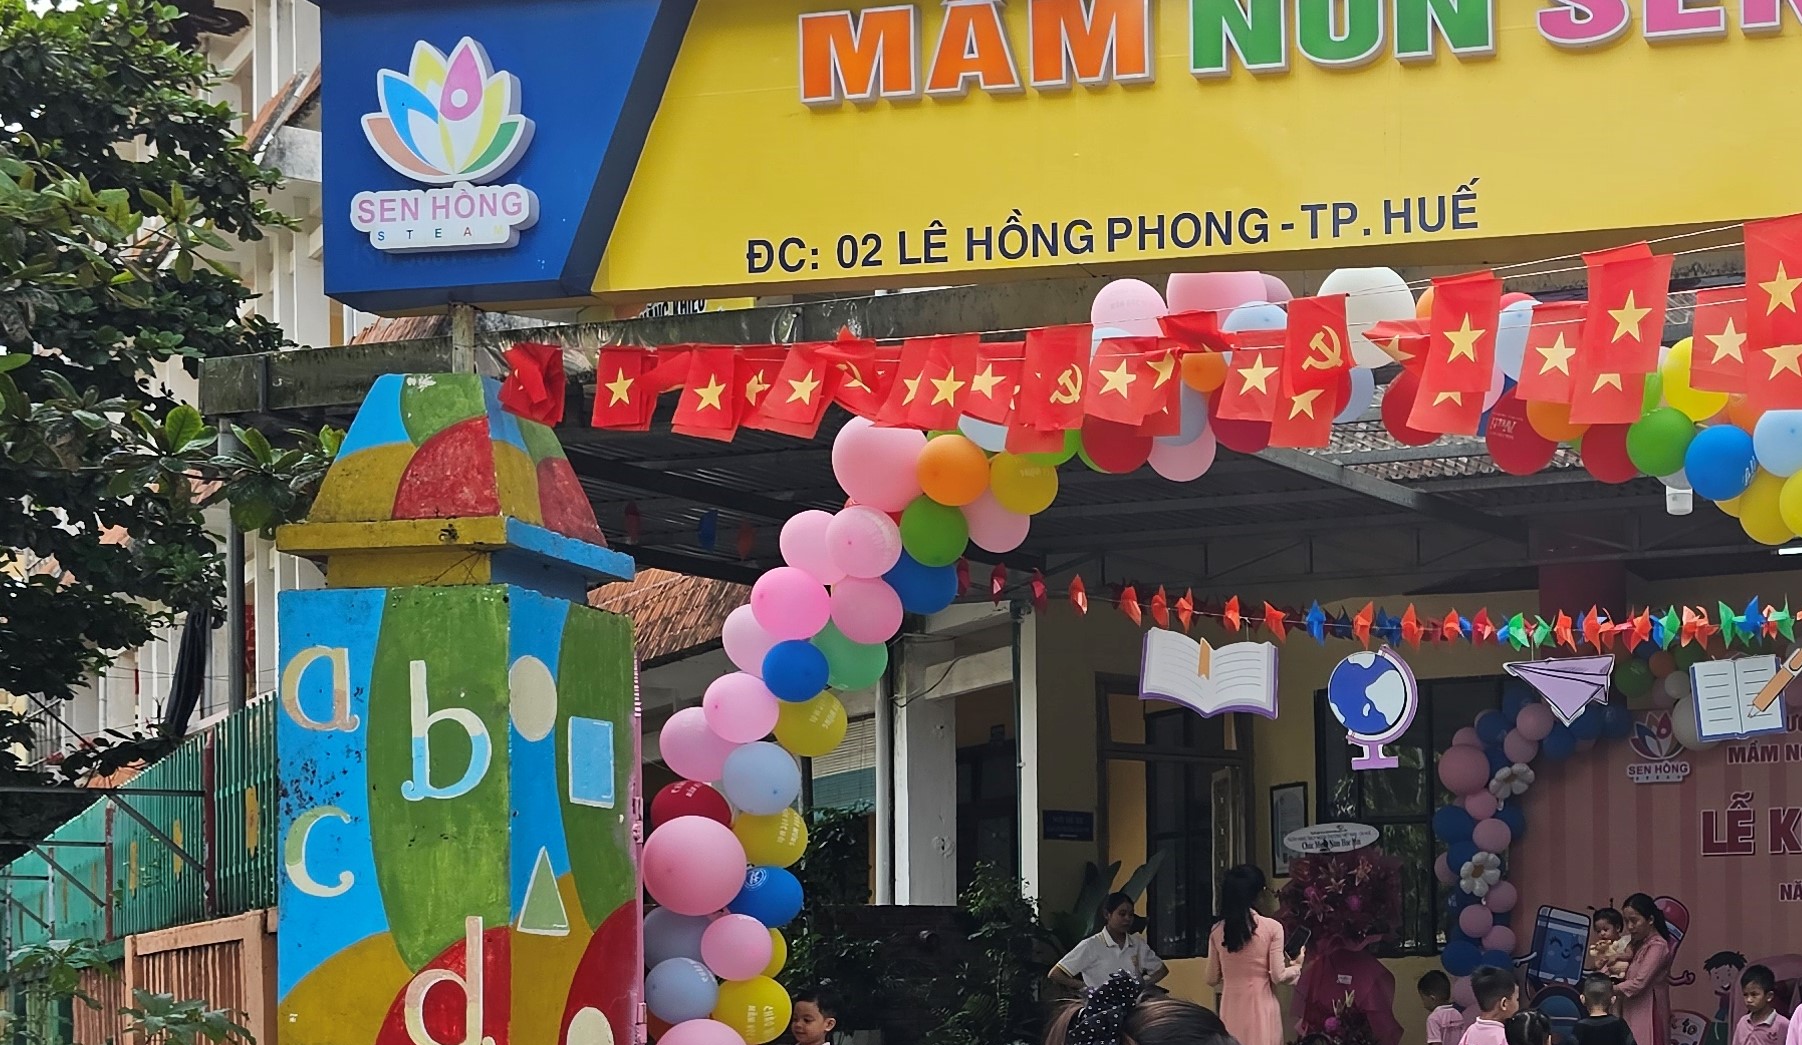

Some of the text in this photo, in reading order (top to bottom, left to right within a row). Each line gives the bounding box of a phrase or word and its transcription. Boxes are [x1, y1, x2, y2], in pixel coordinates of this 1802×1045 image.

[358, 197, 420, 224] SEN
[746, 237, 819, 274] ĐC:
[836, 233, 883, 269] 02
[898, 219, 948, 265] LÊ
[966, 208, 1095, 262] HỒNG
[281, 645, 361, 732] a
[401, 659, 492, 801] b
[1628, 764, 1652, 777] SEN
[284, 804, 355, 898] c
[1701, 791, 1755, 856] LỄ
